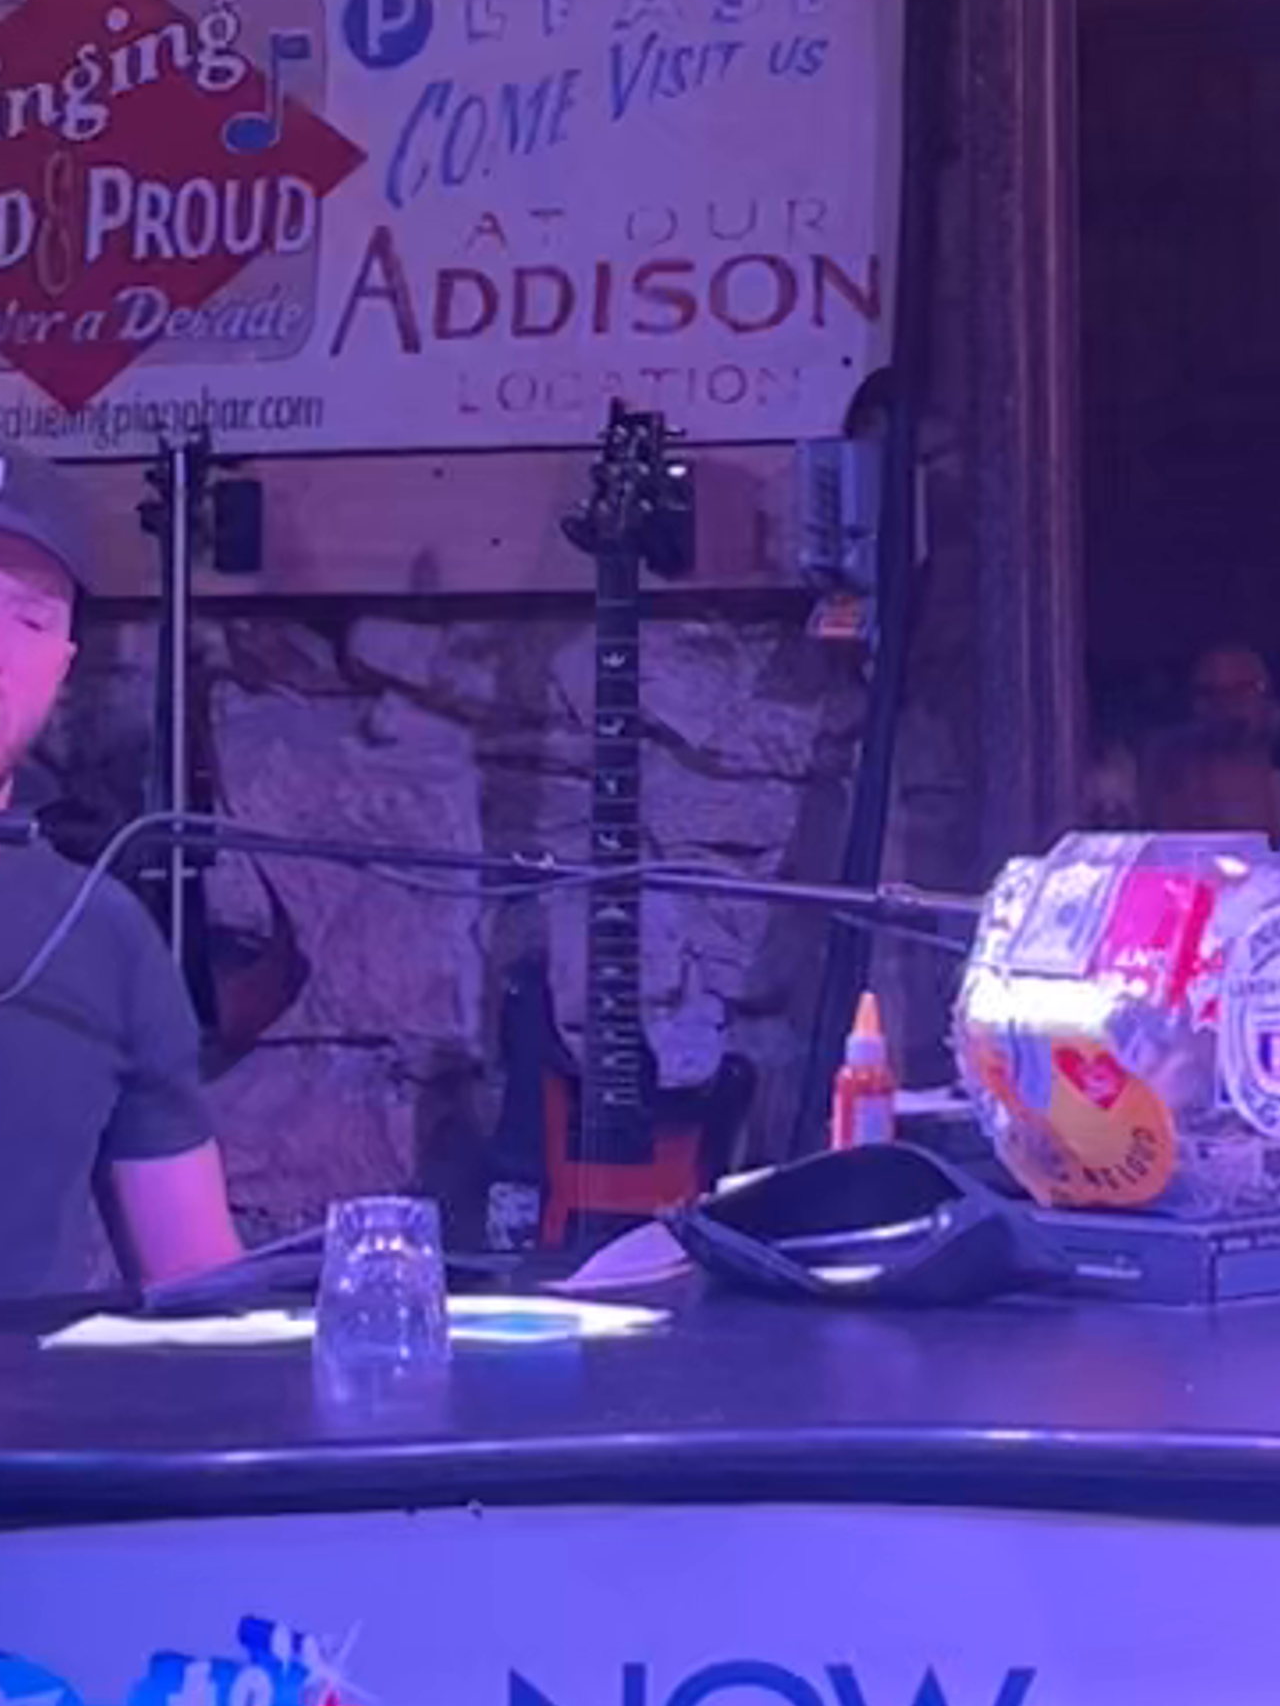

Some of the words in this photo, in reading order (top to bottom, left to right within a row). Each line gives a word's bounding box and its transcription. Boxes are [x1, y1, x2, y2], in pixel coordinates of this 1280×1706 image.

[384, 68, 583, 211] COME
[609, 30, 744, 123] VISIT
[83, 164, 320, 266] PROUD
[463, 208, 565, 254] AT
[624, 197, 828, 246] OUR
[71, 307, 107, 342] a
[114, 285, 306, 343] Decade
[328, 223, 883, 358] ADDISON
